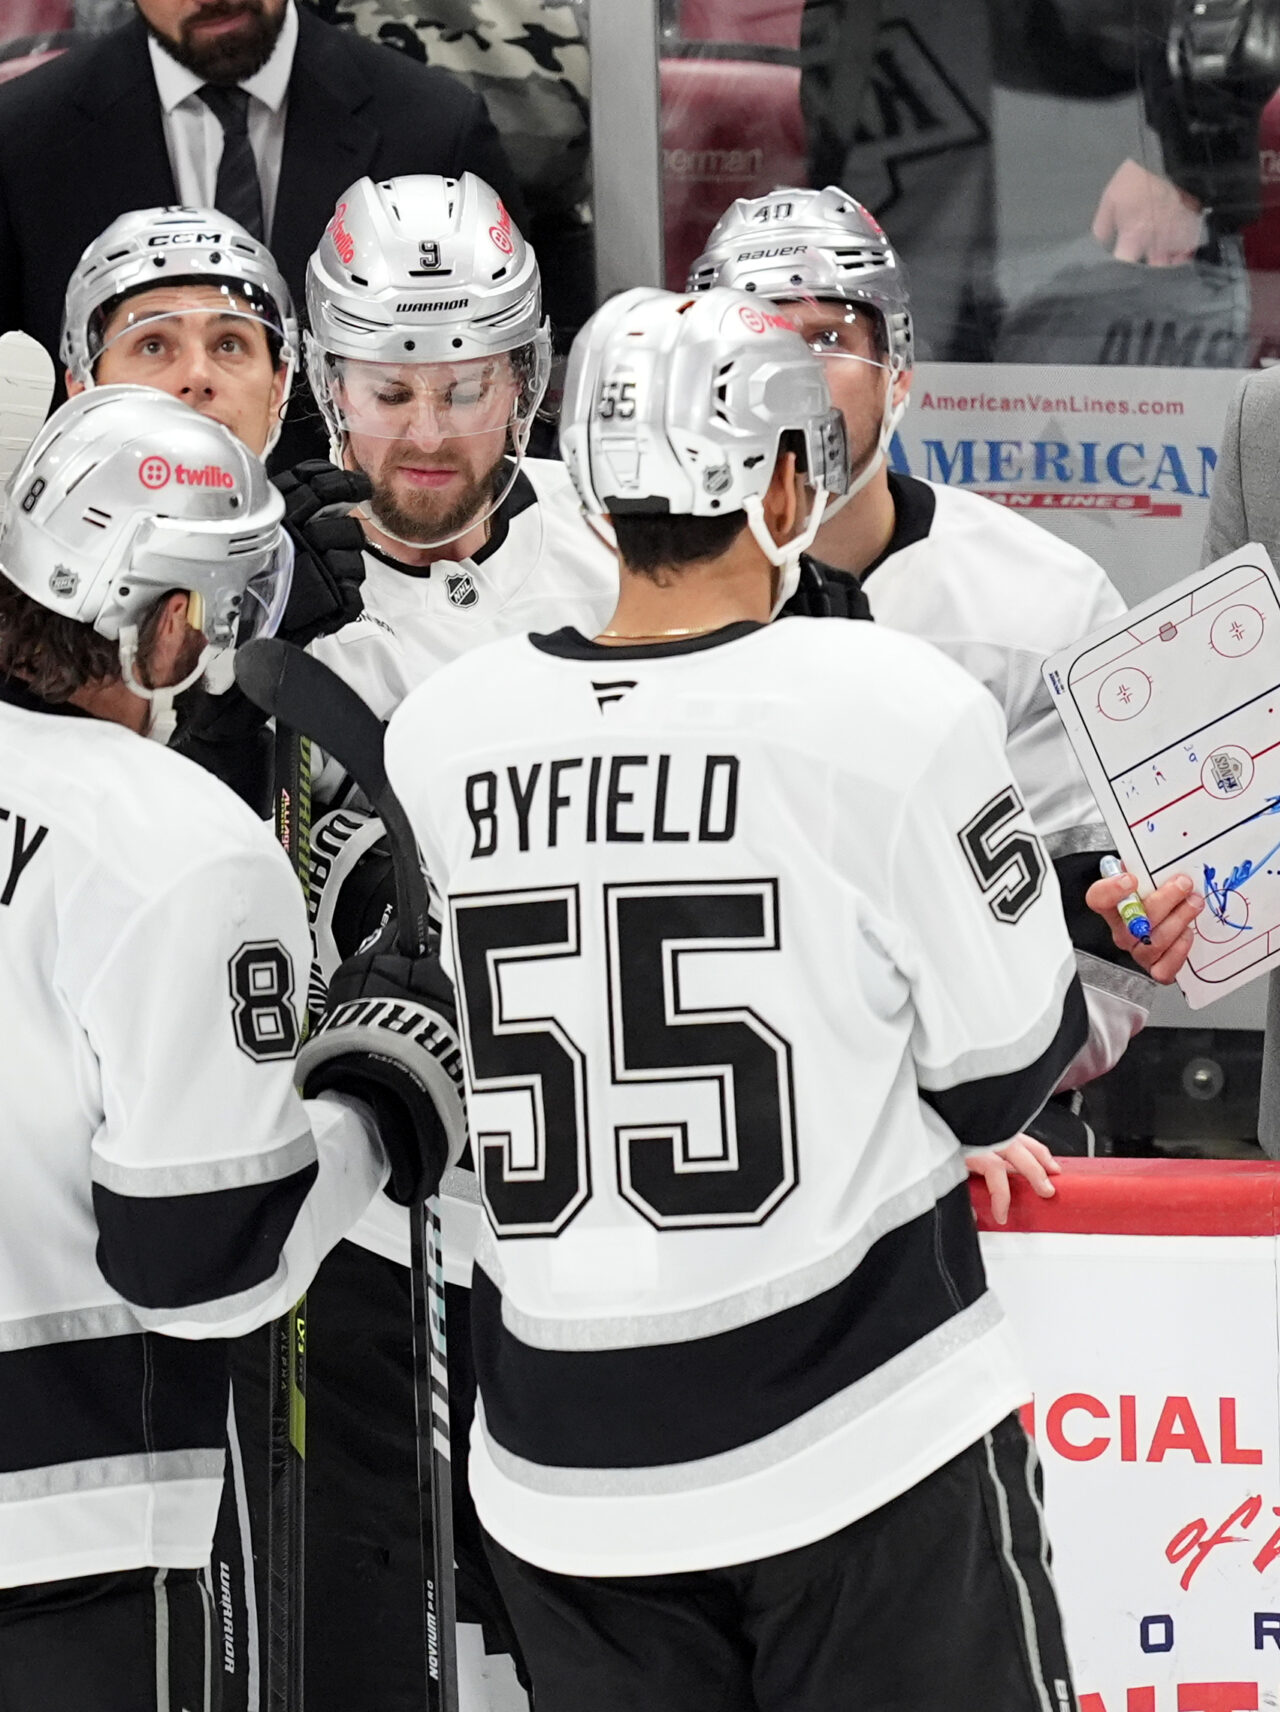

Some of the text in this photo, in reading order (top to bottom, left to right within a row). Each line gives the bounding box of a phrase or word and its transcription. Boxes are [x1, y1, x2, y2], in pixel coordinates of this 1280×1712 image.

[753, 202, 793, 224] 40
[148, 233, 222, 247] CCM
[418, 240, 441, 270] 9
[737, 245, 808, 263] BAUER
[396, 299, 469, 313] WARRIOR
[600, 382, 637, 420] 55
[921, 393, 1185, 416] AmericanVanLines.com
[174, 464, 235, 489] twilio
[22, 478, 46, 513] 8
[1042, 495, 1137, 508] LINES
[465, 754, 741, 860] BYFIELD
[0, 806, 49, 907] Y
[957, 784, 1048, 926] 5
[228, 938, 303, 1065] 8
[448, 877, 801, 1240] 55
[1163, 1493, 1264, 1592] of
[219, 1560, 235, 1675] WARRIOR
[427, 1579, 439, 1681] NOVIUM PRO
